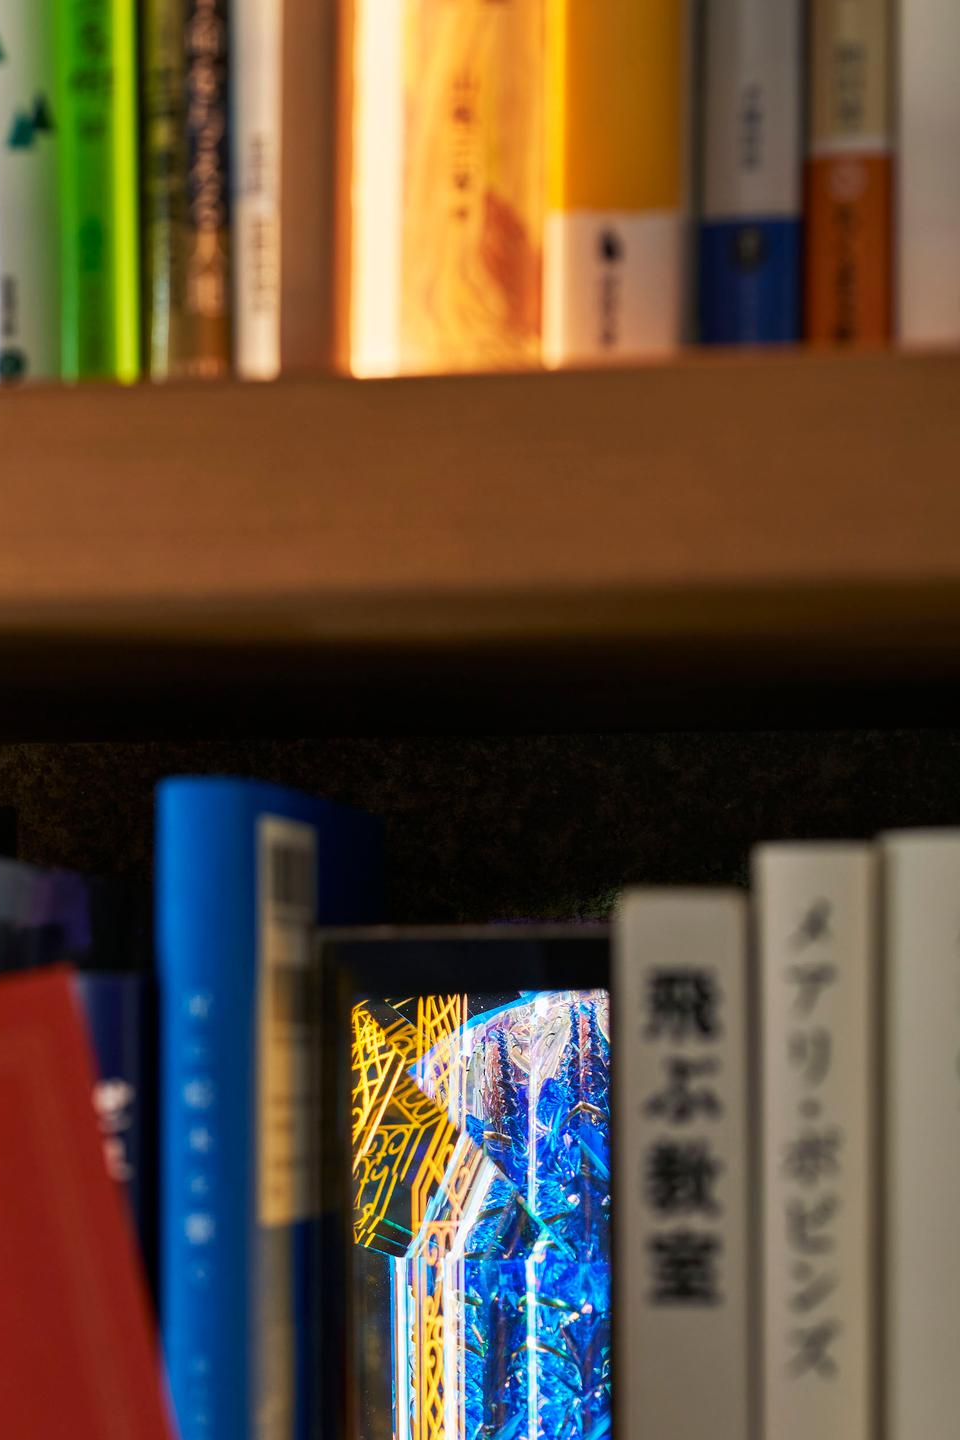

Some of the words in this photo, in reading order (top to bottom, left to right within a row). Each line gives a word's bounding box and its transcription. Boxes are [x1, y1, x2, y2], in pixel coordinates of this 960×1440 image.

[643, 967, 725, 1308] 飛ぶ教室
[785, 899, 845, 1380] メアリ・ポピンズ
